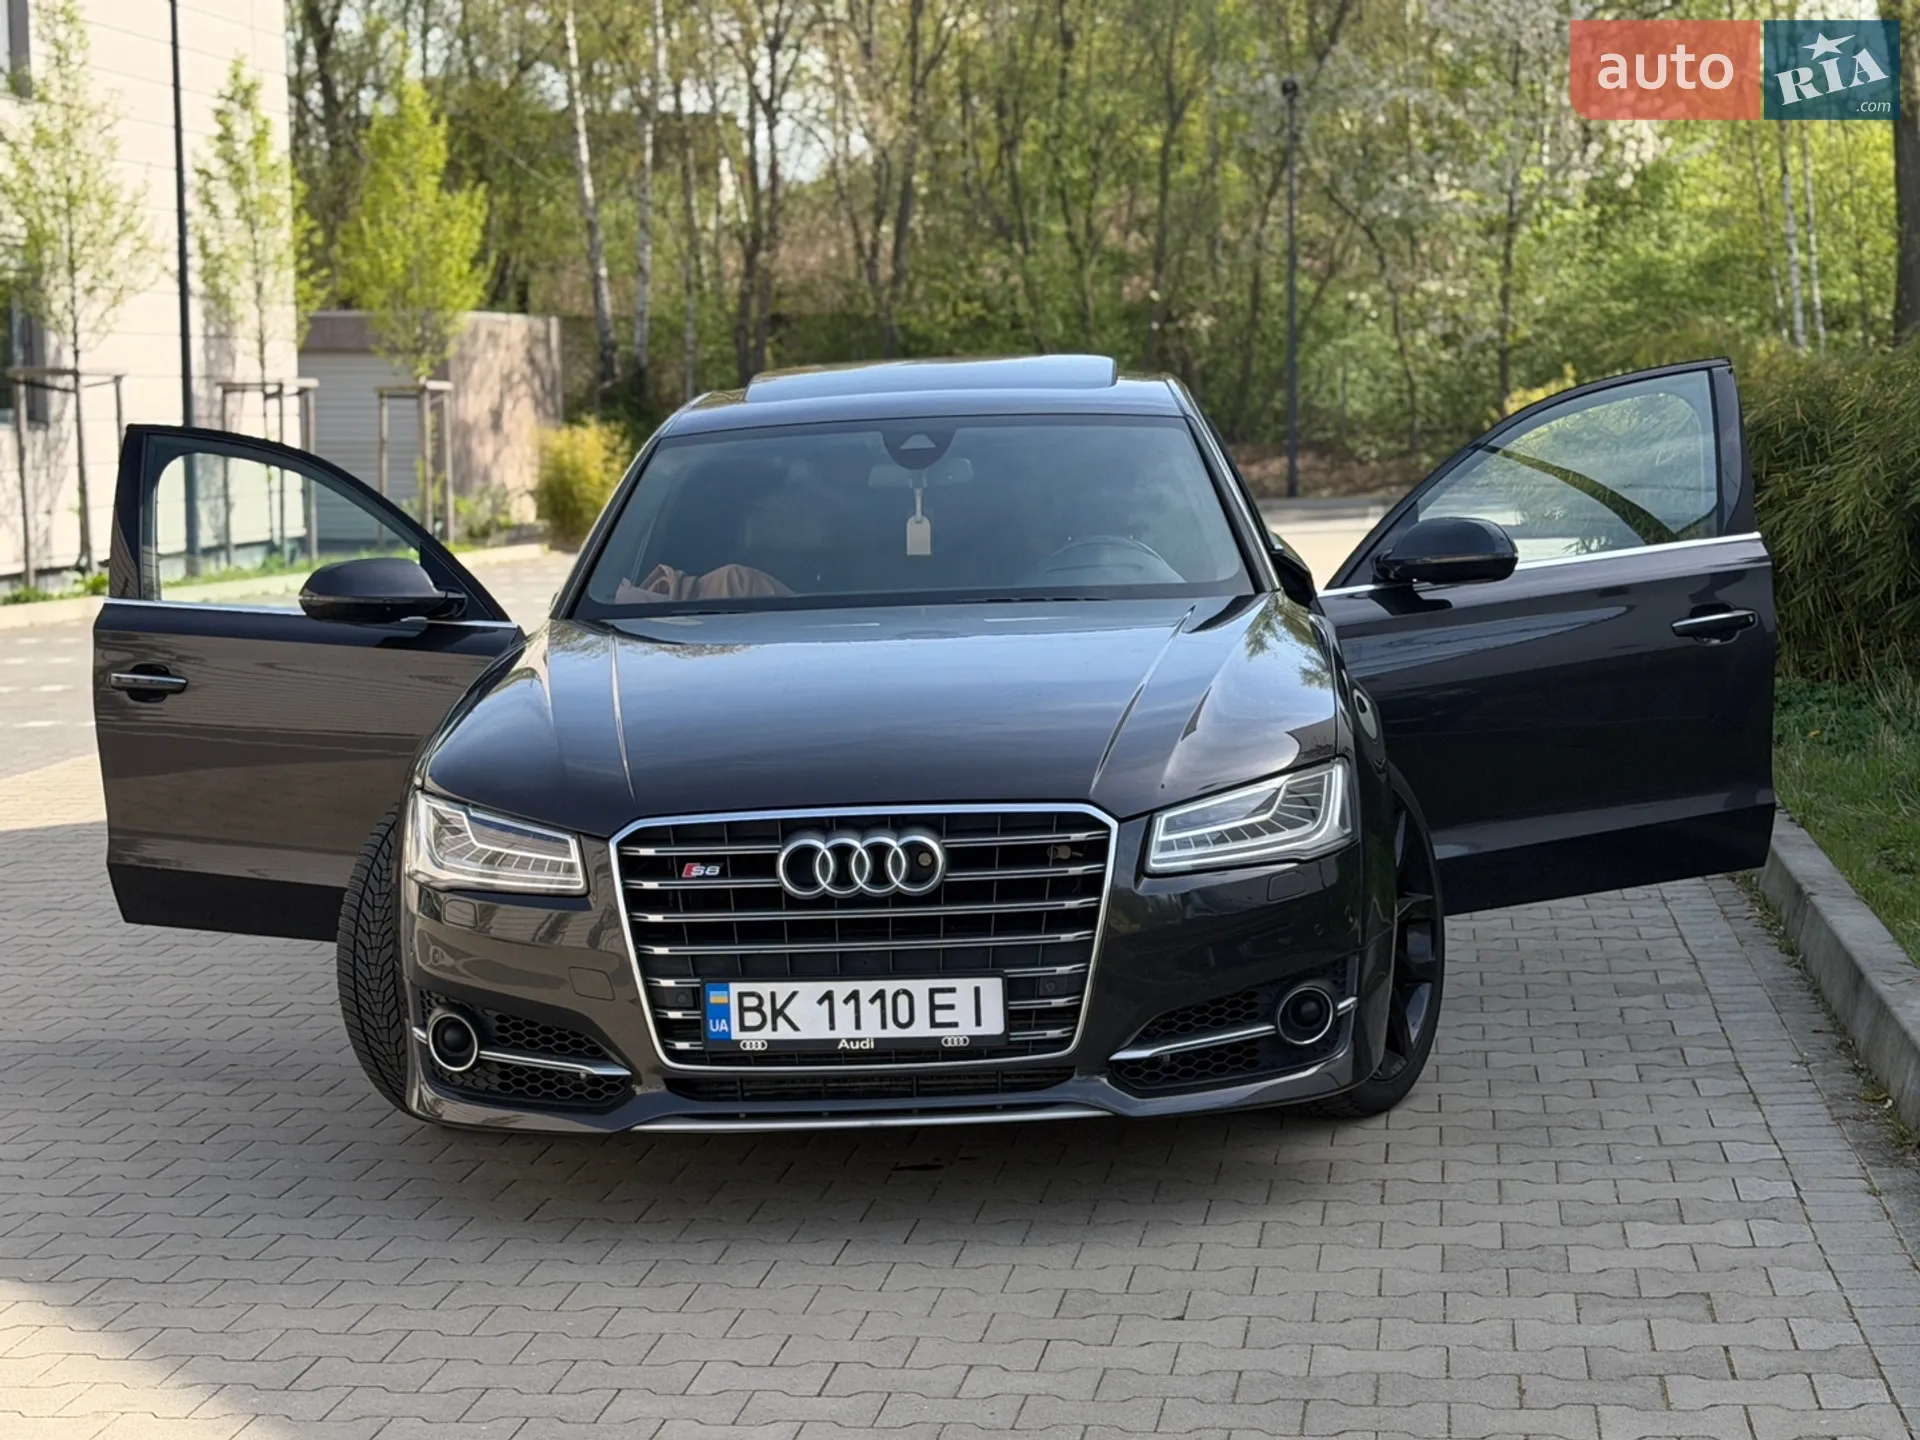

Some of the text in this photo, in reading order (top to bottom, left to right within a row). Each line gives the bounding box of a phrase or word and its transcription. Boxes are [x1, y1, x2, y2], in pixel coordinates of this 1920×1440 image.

[690, 865, 720, 876] S8
[737, 986, 982, 1032] BK 1110 EI
[709, 1019, 729, 1032] UA
[837, 1038, 875, 1050] Audi
